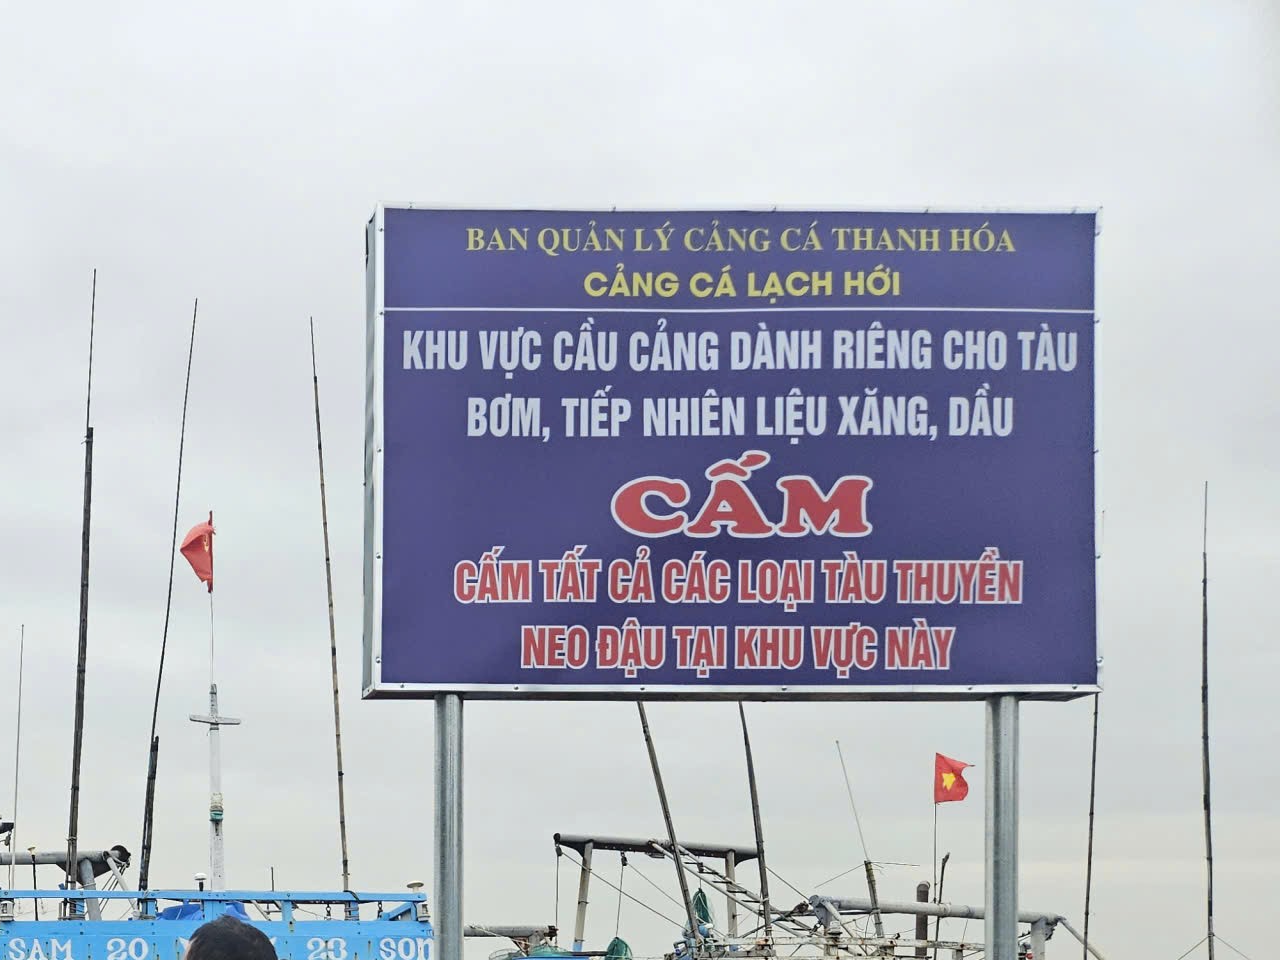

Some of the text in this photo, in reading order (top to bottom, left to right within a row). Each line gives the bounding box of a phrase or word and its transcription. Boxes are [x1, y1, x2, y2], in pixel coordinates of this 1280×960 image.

[465, 219, 1017, 257] BAN QUẢN LÝ CẢNG CÁ THANH HÓA
[583, 262, 901, 304] CẢNG CÁ LẠCH HỚI
[403, 316, 1078, 380] KHU VỰC CẦU CẢNG DÀNH RIÊNG CHO TÀU
[467, 382, 1014, 445] BƠM, TIẾP NHIÊN LIỆU XĂNG, DẦU
[610, 449, 874, 539] CẤM
[453, 544, 1024, 613] CẤM TẤT CẢ CÁC LOẠI TÀU THUYỀN
[520, 616, 957, 679] NEO ĐẬU TẠI KHU VỰC NÀY
[106, 937, 149, 960] 20
